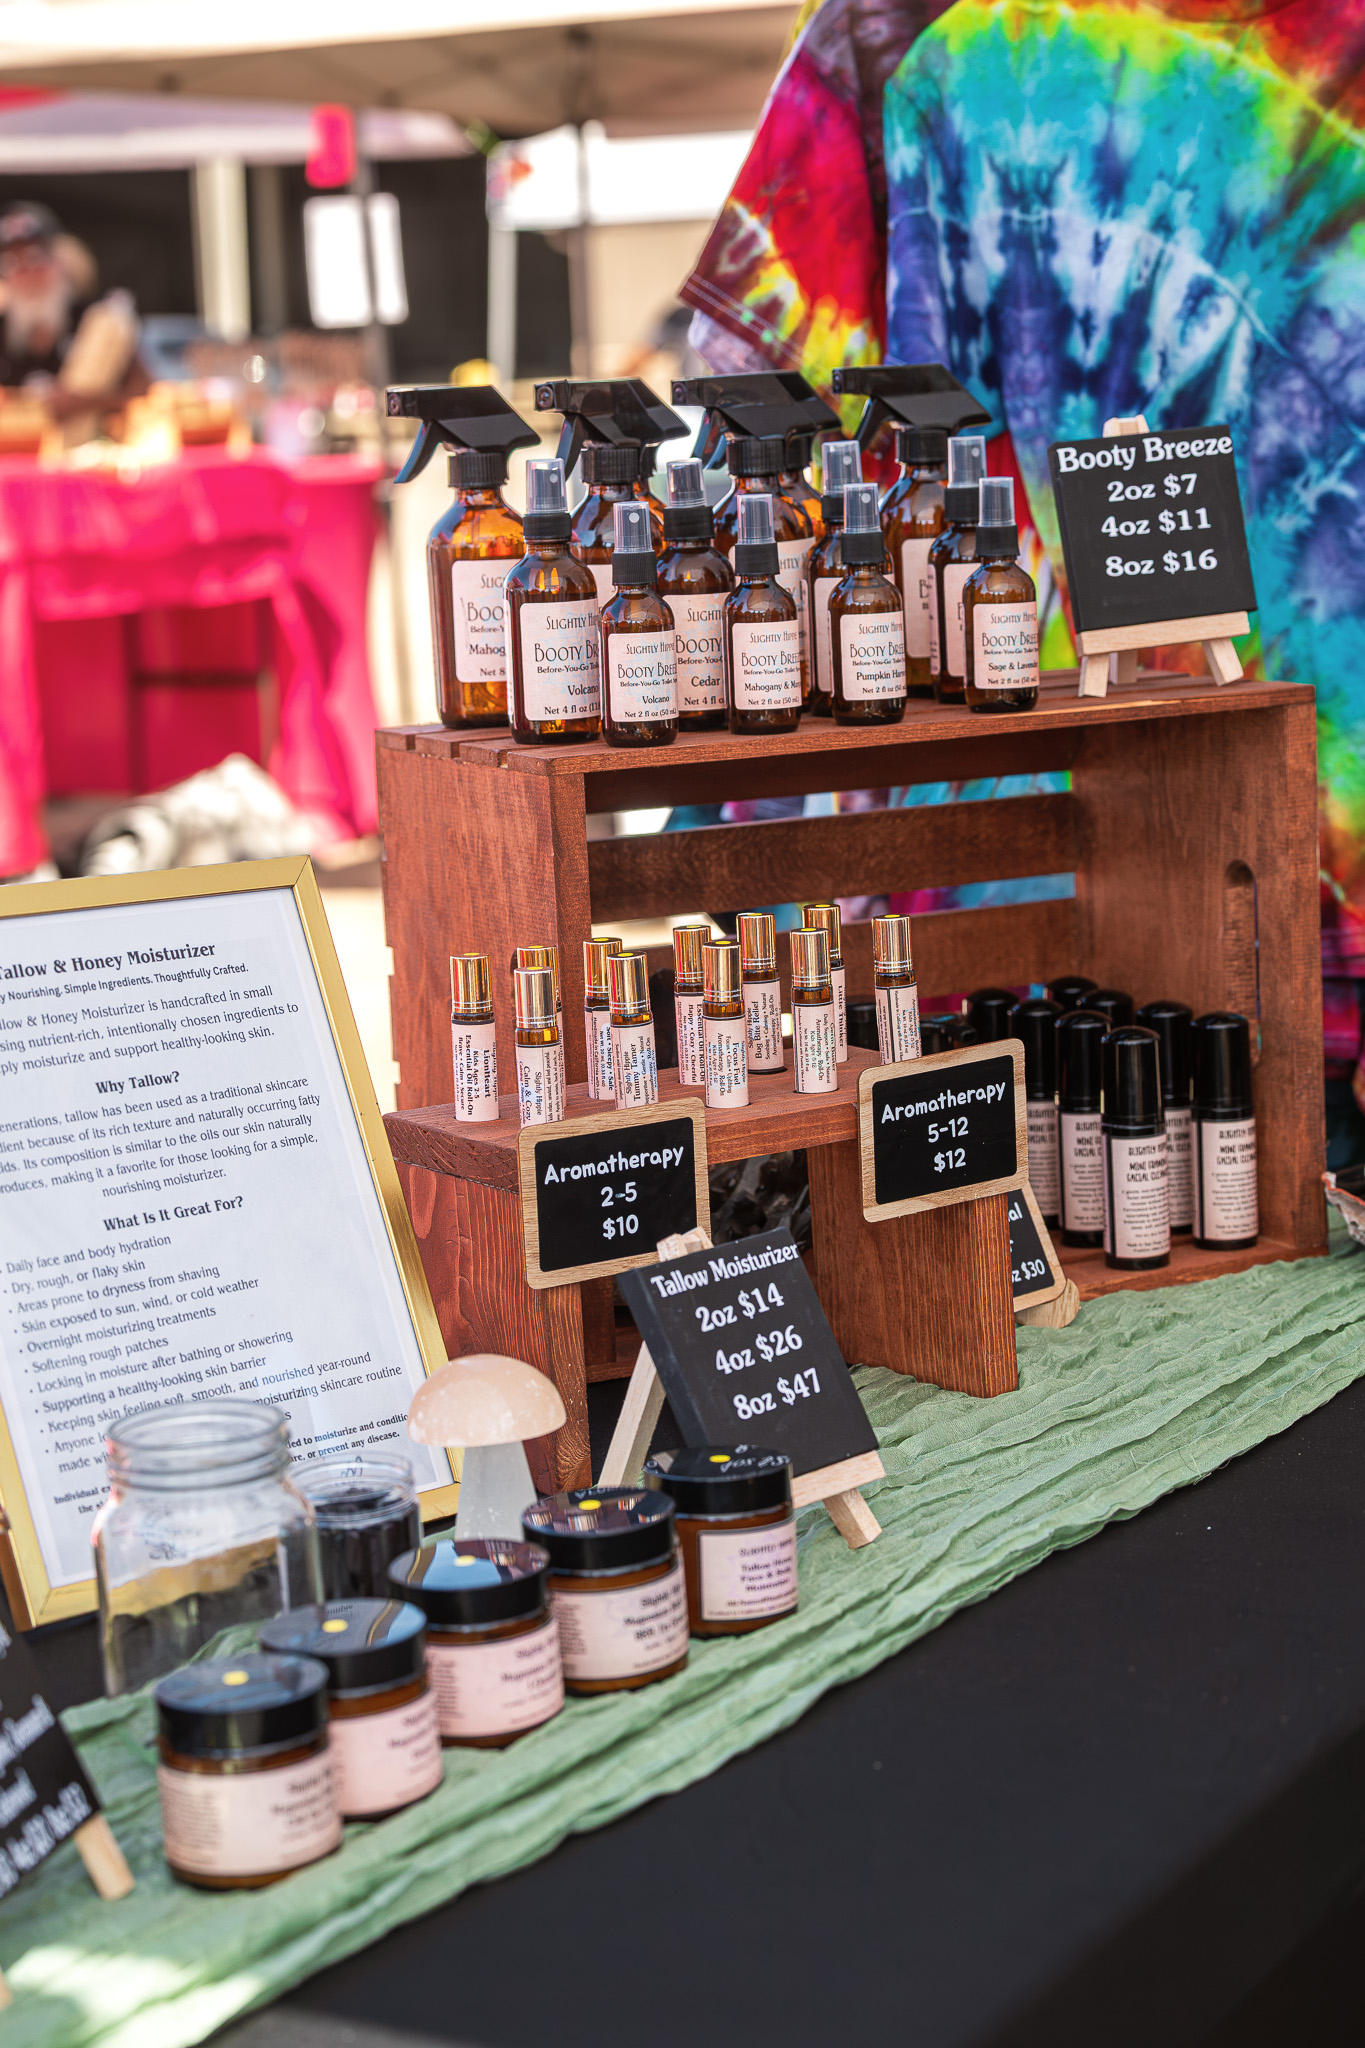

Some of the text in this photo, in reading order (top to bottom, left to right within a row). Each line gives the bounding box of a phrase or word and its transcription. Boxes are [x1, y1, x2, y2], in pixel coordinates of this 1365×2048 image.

[1057, 436, 1233, 472] Booty Breeze
[1107, 473, 1197, 502] 2oz $7
[1102, 507, 1212, 537] 4oz $11
[1106, 549, 1218, 576] 8oz $16
[547, 616, 586, 630] SLIGHTLY
[859, 624, 889, 634] SLIGHTLY
[991, 613, 1021, 624] SLIGHTLY
[676, 635, 722, 653] BOOTY
[750, 632, 781, 643] SLIGHTLY
[982, 632, 1017, 647] BOOTY
[535, 643, 582, 662] BOOTY
[626, 644, 658, 655] SLIGHTLY
[742, 653, 778, 666] BOOTY
[850, 644, 885, 658] BOOTY
[480, 668, 495, 676] Net
[537, 662, 588, 674] Before-You-Go
[618, 663, 654, 678] BOOTY
[857, 671, 890, 681] Pumpkin
[988, 663, 1005, 672] Sage
[568, 685, 599, 696] Volcano
[691, 676, 720, 687] Cedar
[745, 681, 789, 692] Mahogany &
[545, 706, 560, 715] Net
[643, 695, 669, 704] Volcano
[684, 697, 699, 705] Net
[53, 959, 67, 973] &
[71, 956, 122, 971] Honey
[126, 944, 215, 965] Moisturizer
[7, 962, 249, 1000] Nourishing. Simple Ingredients. Thoughtfully Crafted.
[26, 984, 273, 1026] & Honey Moisturizer is handcrafted in small
[752, 1001, 760, 1023] Relief
[28, 1003, 298, 1047] nutrient-rich, intentionally chosen ingredients to
[22, 1025, 274, 1069] moisturize and support healthy-looking skin.
[755, 1043, 763, 1059] Bug
[95, 1070, 179, 1094] Why Tallow?
[64, 1078, 308, 1122] tallow has been used as a traditional skincare
[881, 1083, 1005, 1124] Aromatherapy
[927, 1117, 969, 1143] 5-12
[544, 1146, 684, 1184] Aromatherapy
[933, 1147, 966, 1173] $12
[601, 1182, 638, 1208] 2-5
[103, 1195, 243, 1230] What Is It Great For?
[601, 1214, 639, 1241] $10
[651, 1242, 800, 1300] Tallow Moisturizer
[1021, 1259, 1045, 1280] $30
[696, 1281, 784, 1333] 2oz $14
[715, 1324, 803, 1376] 4oz $26
[261, 1351, 371, 1385] nourished year-round
[320, 1366, 402, 1392] skincare routine
[733, 1367, 822, 1421] 8oz $47
[315, 1428, 357, 1442] moisturize
[359, 1421, 374, 1432] and
[308, 1431, 400, 1458] or prevent any disease.
